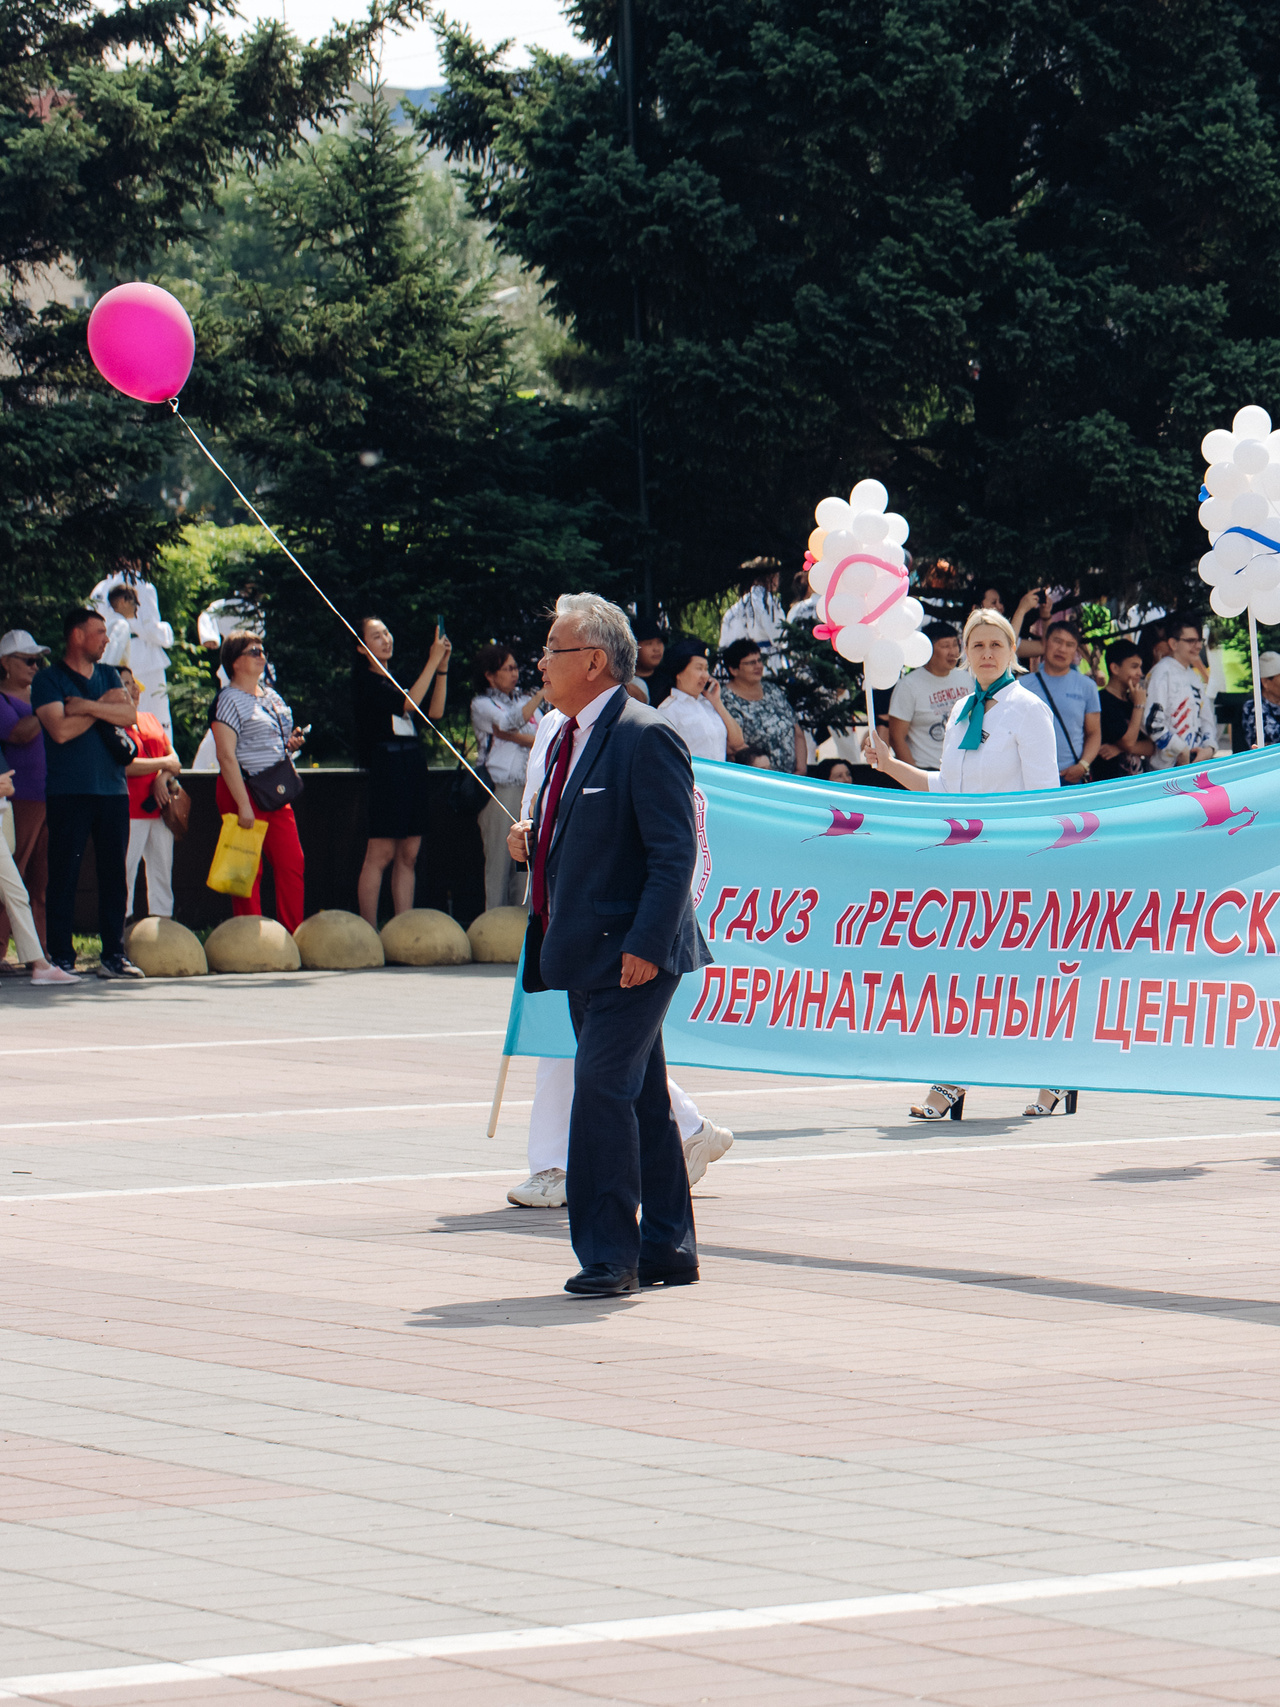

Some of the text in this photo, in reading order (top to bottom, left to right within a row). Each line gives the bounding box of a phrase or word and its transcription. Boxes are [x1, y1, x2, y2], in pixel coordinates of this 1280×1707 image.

[929, 686, 969, 705] LEGENDARY
[708, 886, 819, 945] ГАУЗ
[689, 961, 1082, 1041] ПЕРИНАТАЛЬНЫЙ
